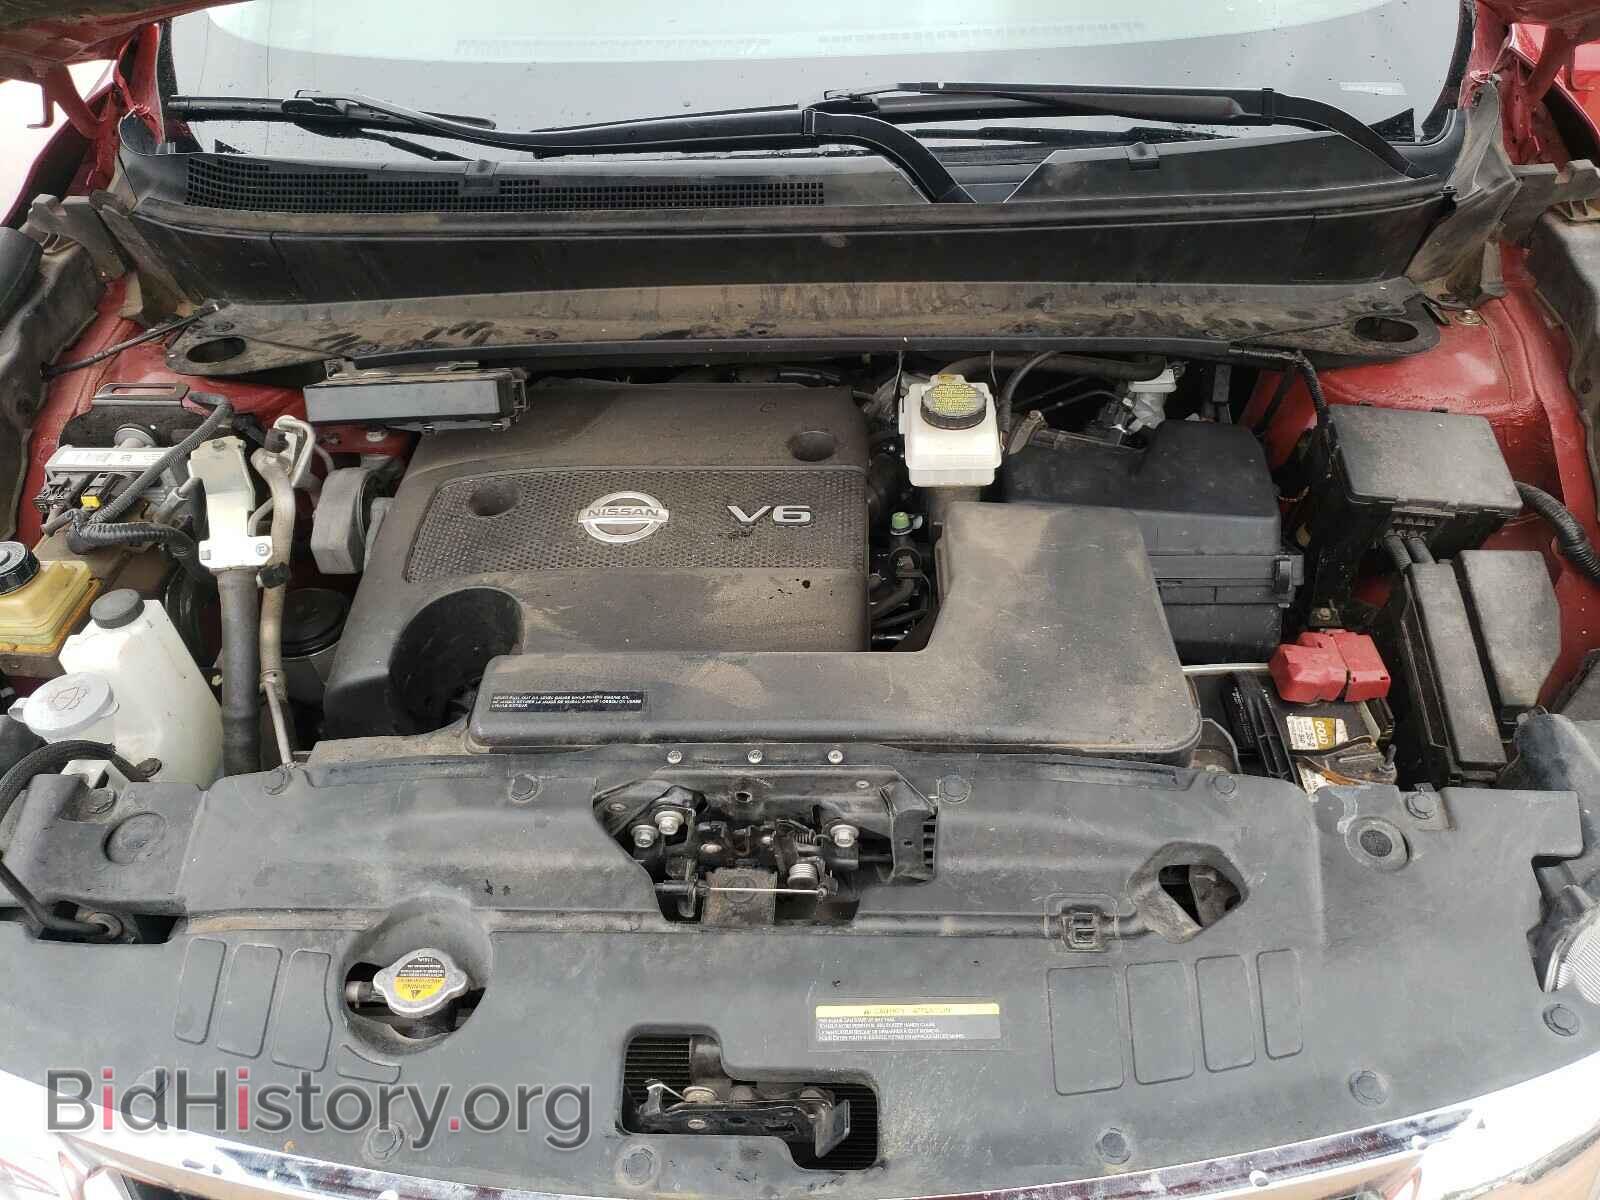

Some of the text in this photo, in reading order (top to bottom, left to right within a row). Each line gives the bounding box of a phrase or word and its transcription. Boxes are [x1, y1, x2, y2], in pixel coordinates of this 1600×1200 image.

[587, 507, 660, 517] NISSAN
[726, 504, 813, 526] V6
[1315, 720, 1329, 744] GOLD
